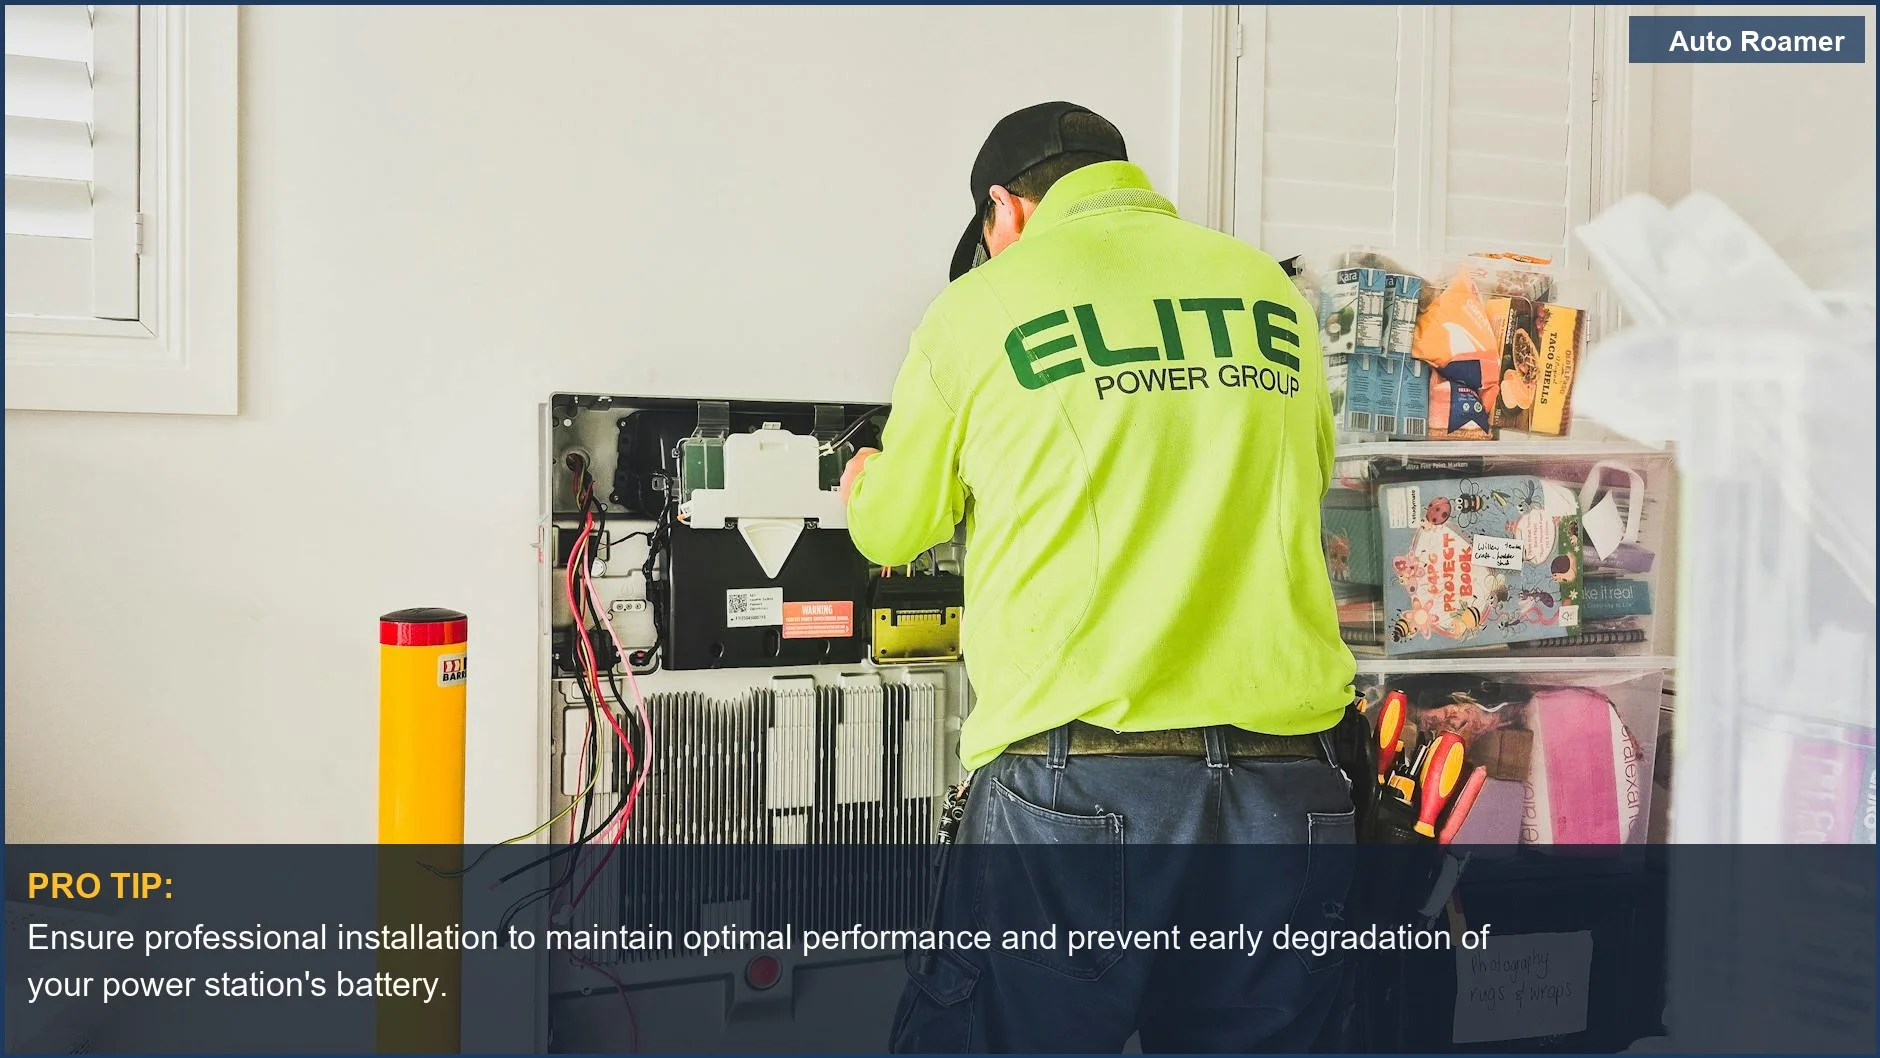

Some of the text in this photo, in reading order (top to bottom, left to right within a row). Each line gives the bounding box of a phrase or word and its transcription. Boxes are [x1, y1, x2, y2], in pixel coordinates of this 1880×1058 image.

[1004, 297, 1300, 391] ELITE
[1094, 364, 1300, 401] POWER GROUP
[1540, 331, 1558, 405] TACO SHELLS
[1409, 489, 1417, 520] studymate
[1442, 532, 1457, 613] PROJECT
[1458, 545, 1473, 598] BOOK
[801, 604, 834, 616] WARNING
[1582, 584, 1634, 600] ke it real
[1530, 981, 1573, 1007] wraps
